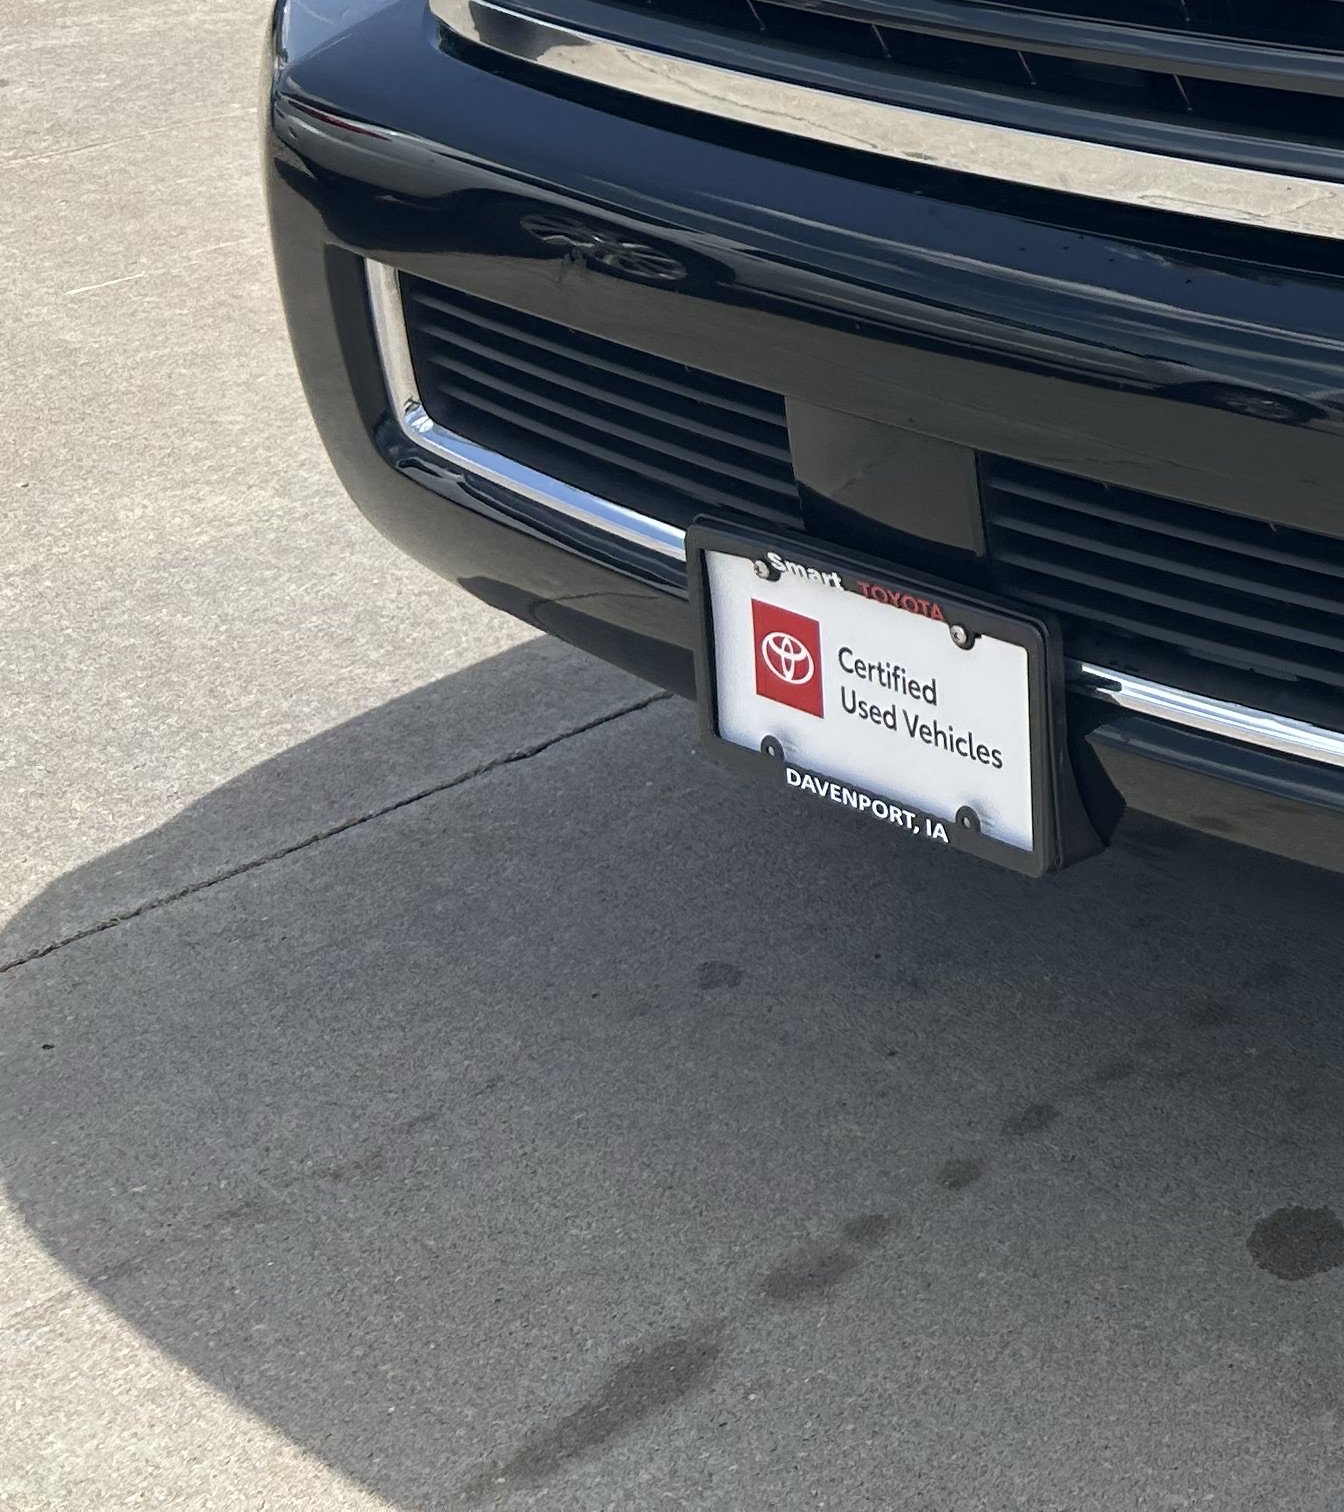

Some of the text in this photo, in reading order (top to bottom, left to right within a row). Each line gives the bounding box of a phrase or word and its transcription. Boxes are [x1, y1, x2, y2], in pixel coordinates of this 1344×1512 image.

[766, 551, 945, 622] Smart TOYOTA
[838, 646, 938, 706] Certified
[841, 685, 1004, 770] Used Vehicles
[785, 767, 951, 844] DAVENPORT, IA
